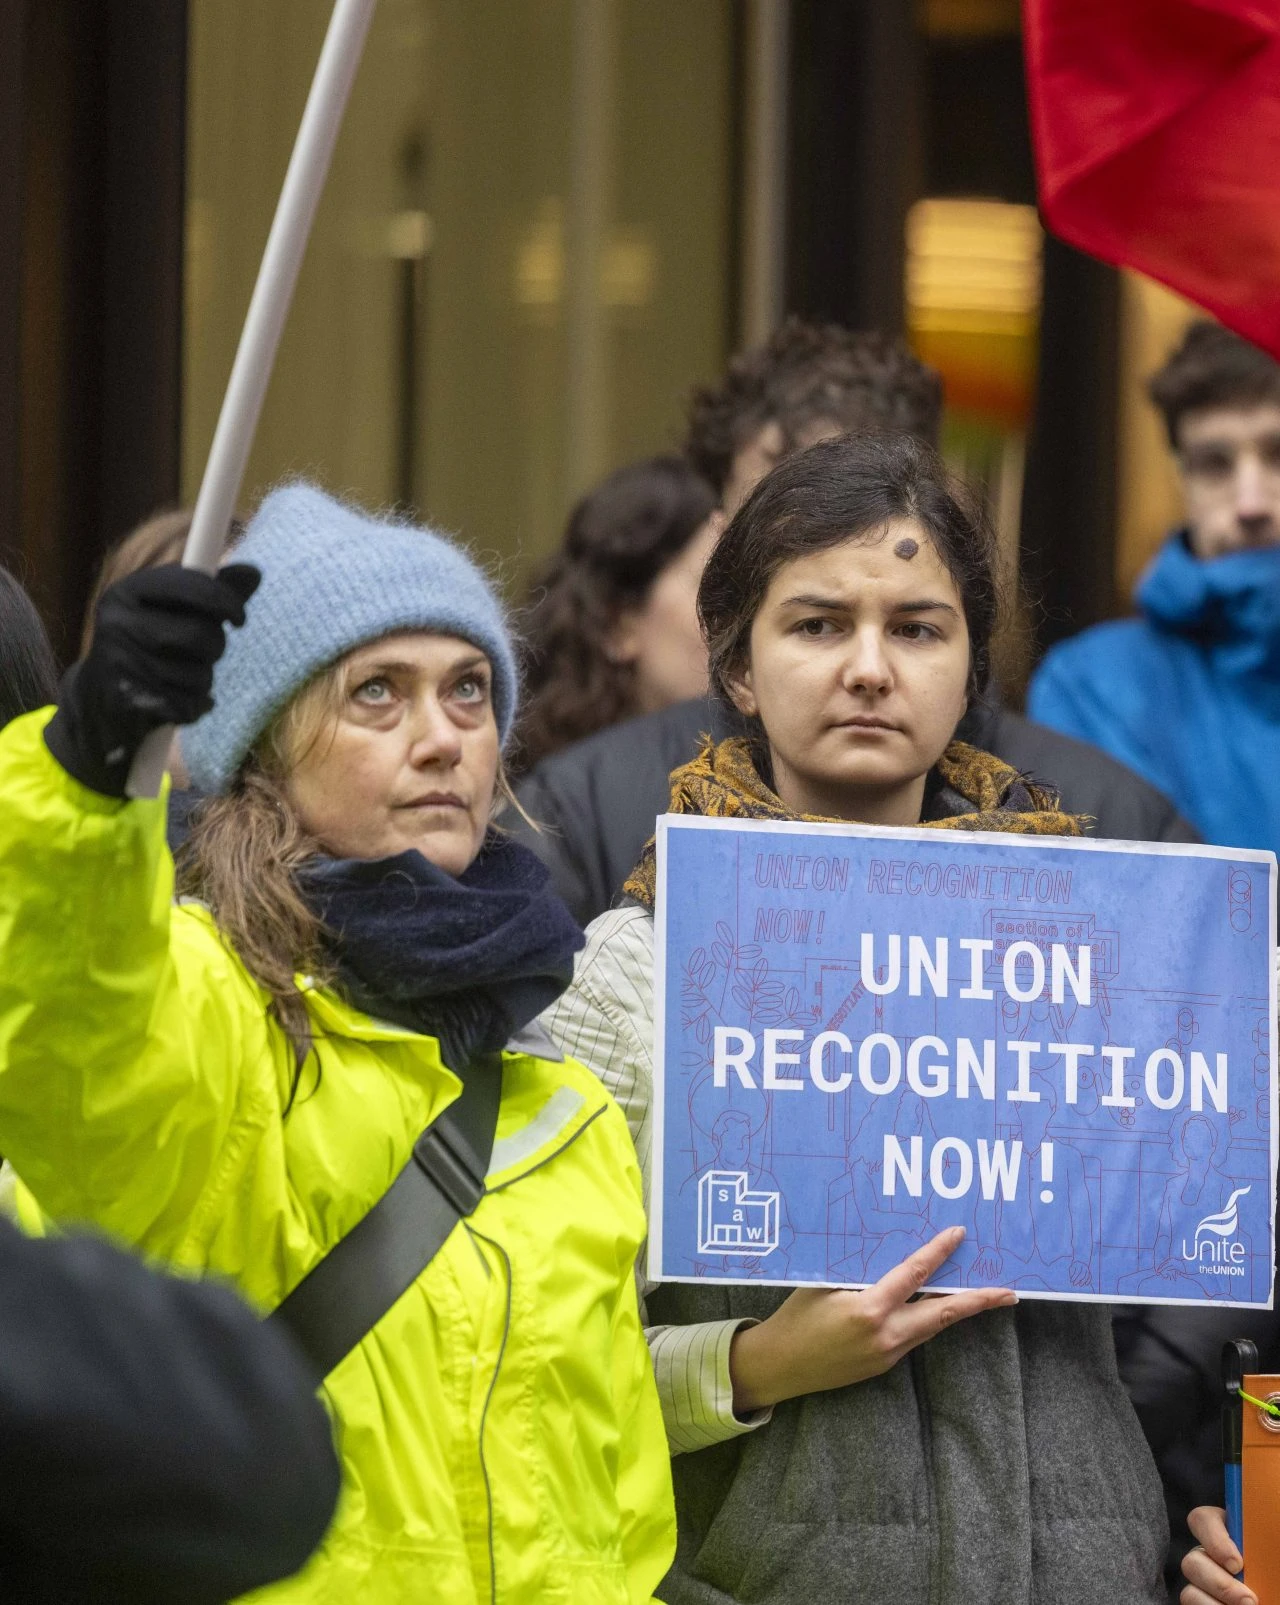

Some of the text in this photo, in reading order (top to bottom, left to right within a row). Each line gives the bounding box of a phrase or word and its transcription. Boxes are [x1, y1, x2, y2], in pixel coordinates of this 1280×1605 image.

[754, 853, 1073, 905] UNION RECOGNITION
[753, 907, 826, 945] NOW!
[859, 932, 1092, 1006] UNION
[712, 1025, 1229, 1114] RECOGNITION
[881, 1134, 1055, 1204] NOW!
